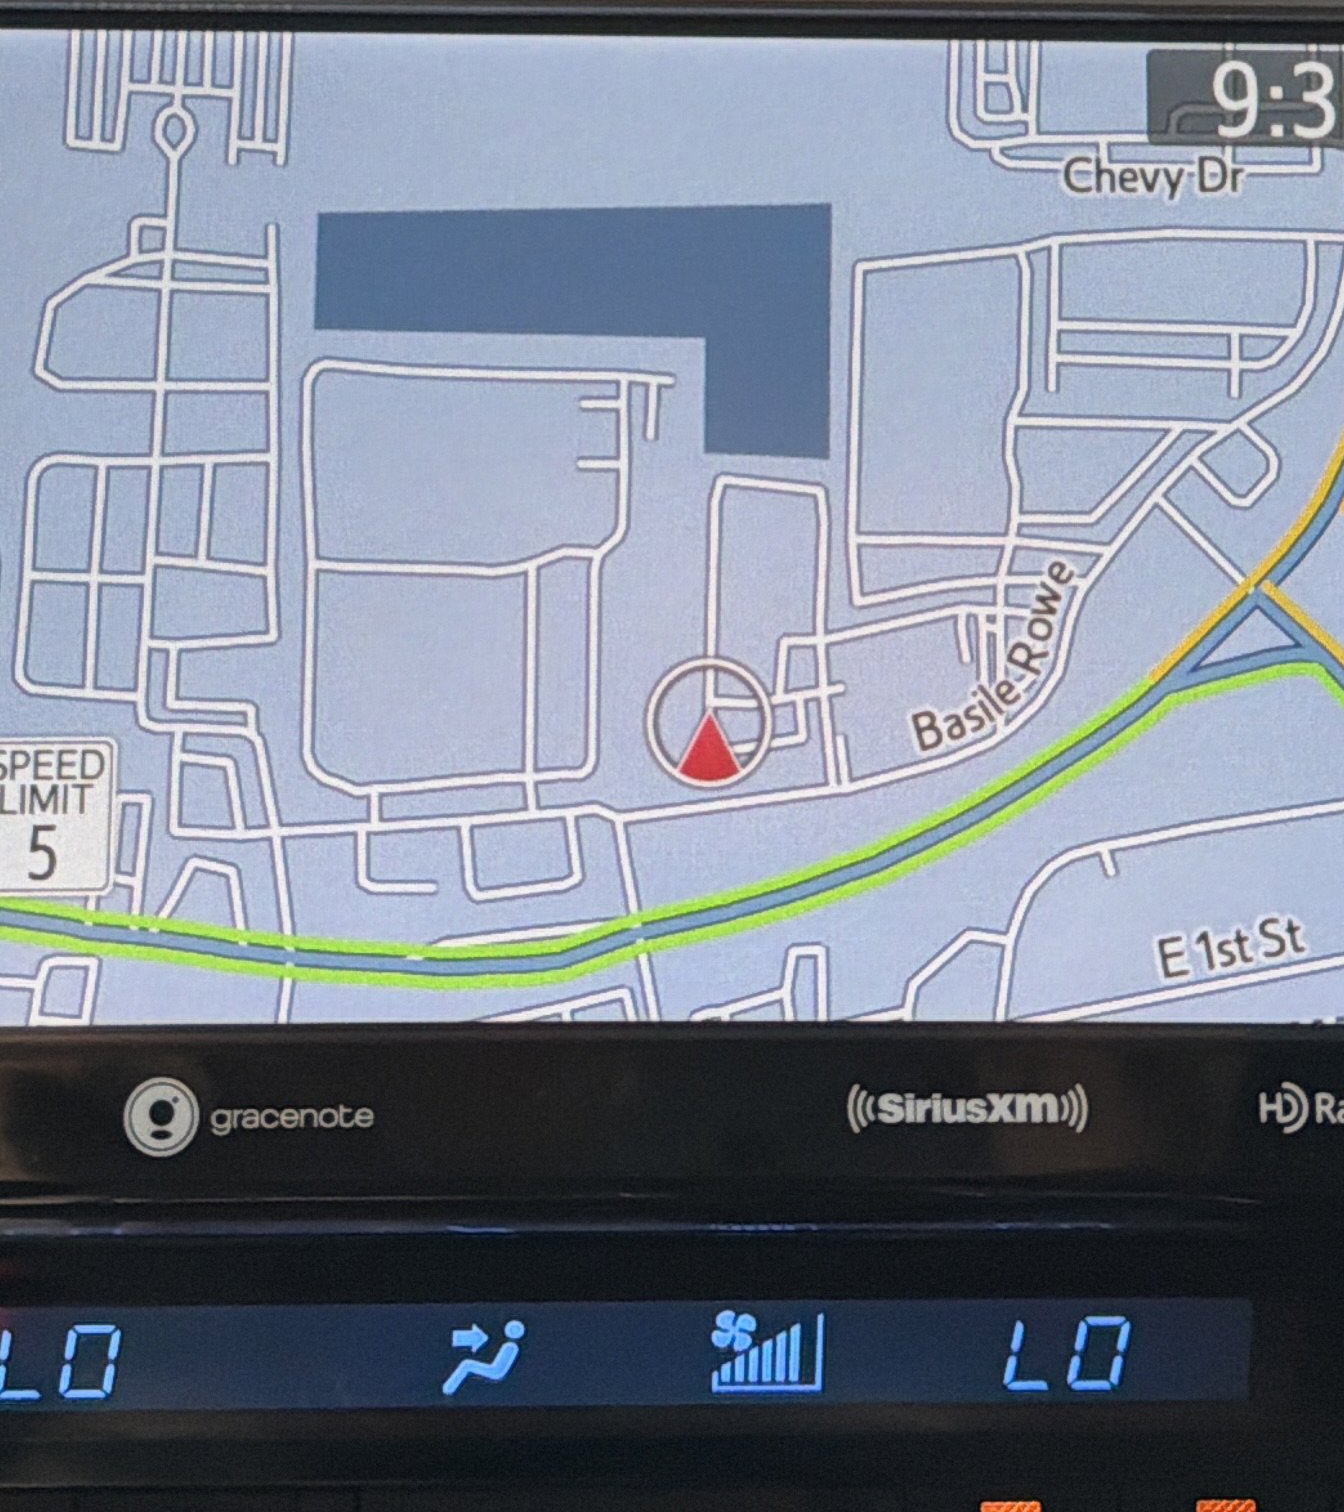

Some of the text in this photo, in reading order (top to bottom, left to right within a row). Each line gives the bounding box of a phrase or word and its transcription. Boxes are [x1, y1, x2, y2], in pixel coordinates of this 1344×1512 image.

[1063, 155, 1244, 200] Chevy Dr
[912, 558, 1075, 751] Basile Rowe
[27, 824, 57, 881] 5
[1158, 916, 1306, 979] E 1st St
[210, 1104, 375, 1136] gracenote
[1002, 1314, 1132, 1392] LO
